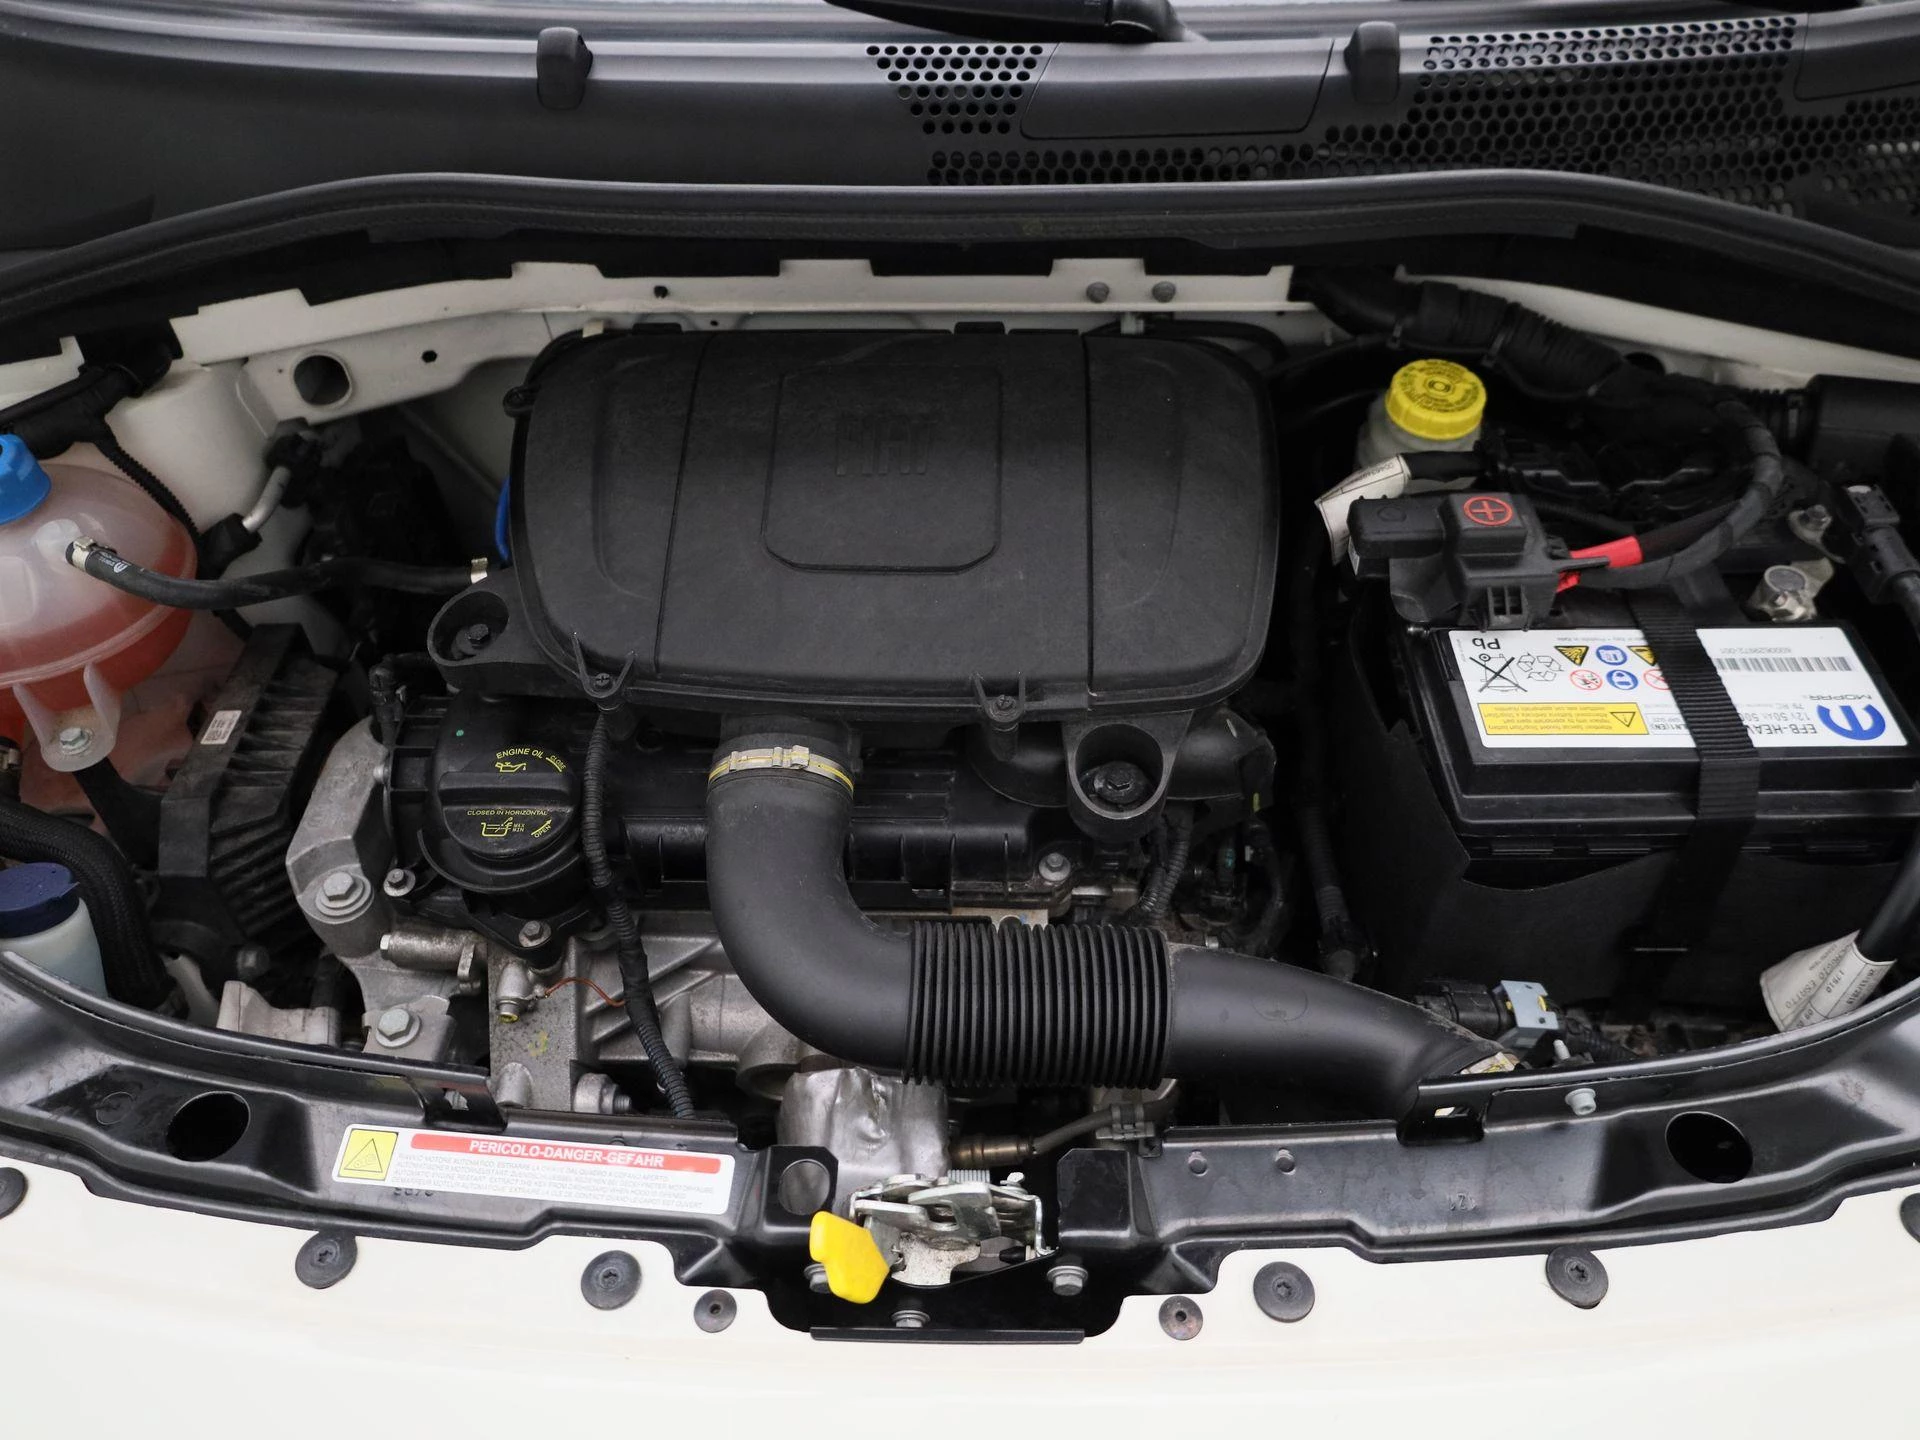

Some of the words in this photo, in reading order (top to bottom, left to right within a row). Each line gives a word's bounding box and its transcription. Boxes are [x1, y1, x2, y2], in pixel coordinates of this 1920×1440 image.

[1471, 636, 1502, 650] Pb
[495, 748, 531, 759] ENGINE
[531, 749, 545, 759] OIL
[549, 755, 567, 770] CLOSE
[535, 824, 552, 838] OPEN
[469, 1140, 664, 1168] PERICOLO-DANGER-GEFAHR
